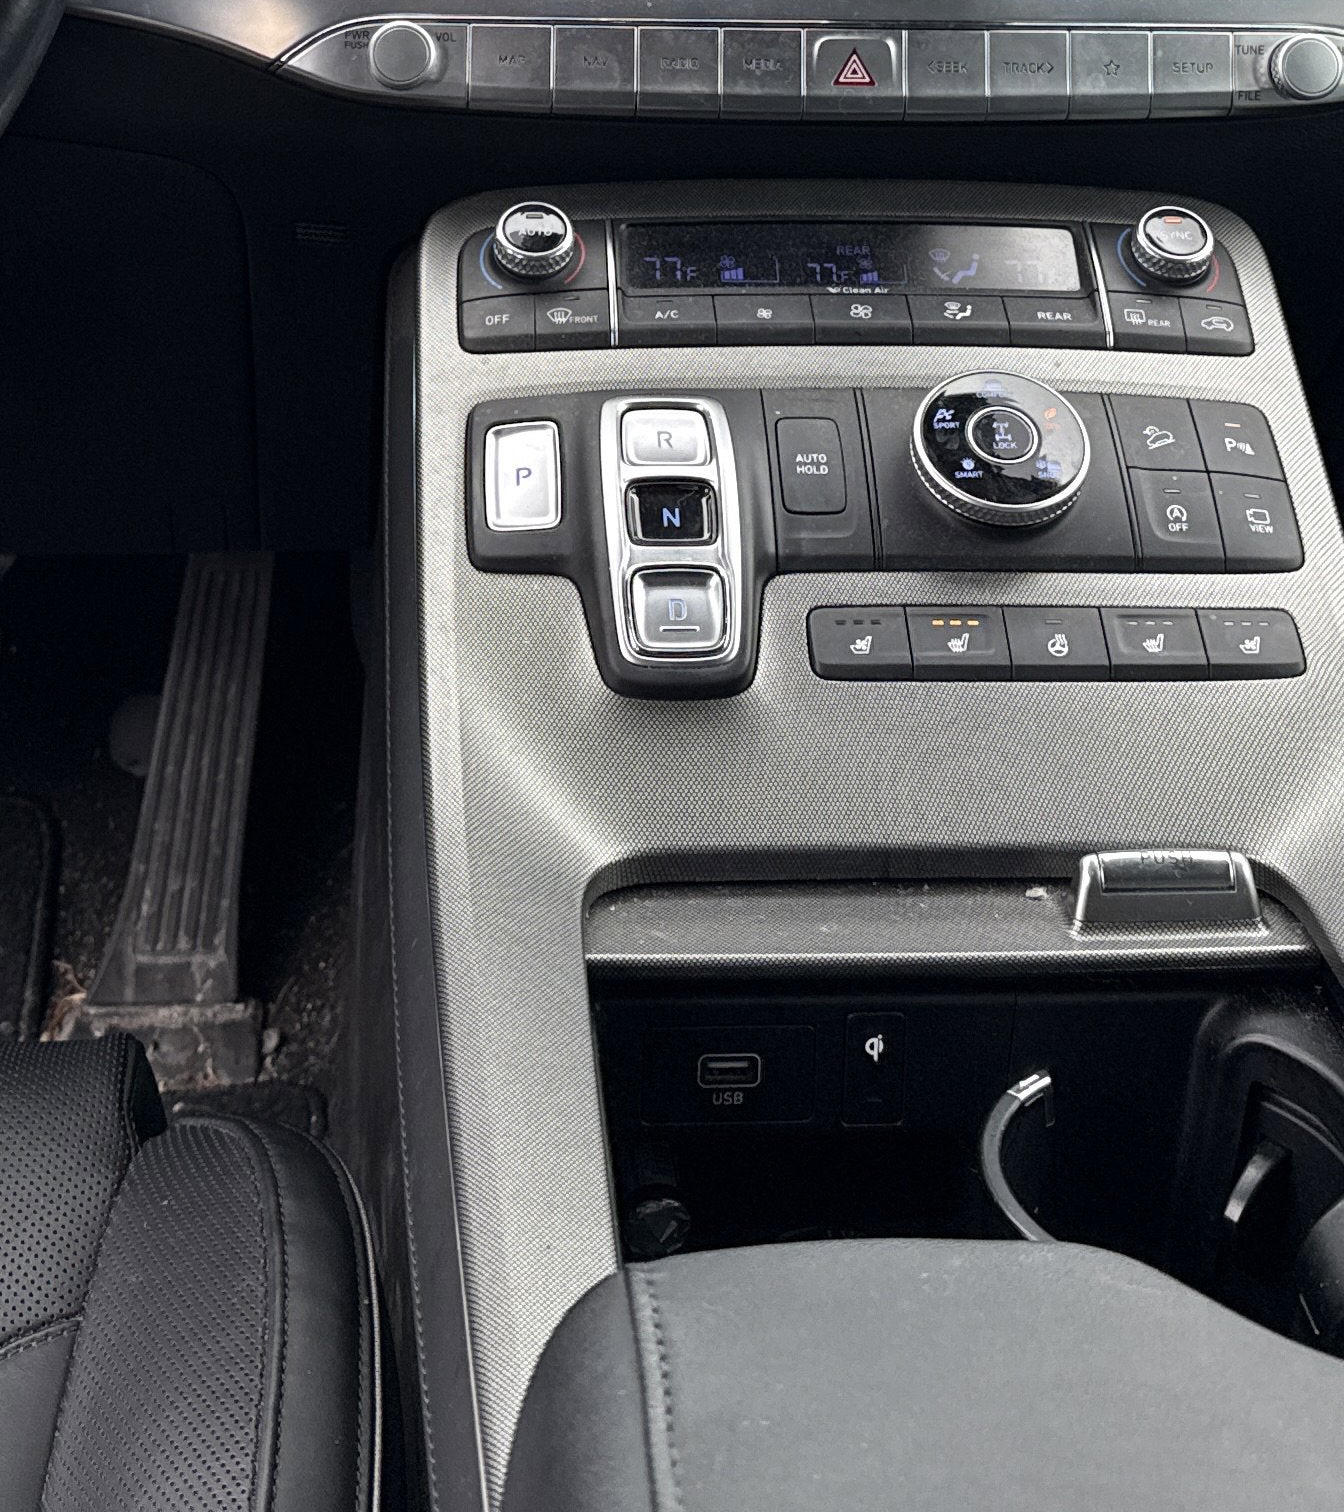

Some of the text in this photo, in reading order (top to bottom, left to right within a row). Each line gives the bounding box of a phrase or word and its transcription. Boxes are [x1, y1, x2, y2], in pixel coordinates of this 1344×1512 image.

[344, 30, 370, 39] PWR
[435, 31, 456, 42] VOL
[344, 41, 369, 50] PUSH
[1235, 44, 1265, 56] TUNE
[498, 54, 525, 65] MAP
[583, 55, 609, 66] NAV
[1171, 61, 1214, 73] SETUP
[1238, 90, 1262, 101] FILE
[517, 228, 554, 237] AUTO
[1159, 231, 1193, 241] SYNC
[836, 245, 871, 256] REAR
[842, 286, 889, 295] Clean Air
[485, 313, 510, 326] OFF
[568, 314, 599, 324] FRONT
[655, 309, 680, 320] A/C
[1036, 311, 1073, 322] REAR
[1147, 319, 1171, 328] REAR
[932, 421, 960, 430] SPORT
[656, 431, 673, 449] R
[992, 441, 1018, 450] LOCK
[795, 453, 827, 463] AUTO
[796, 464, 828, 475] HOLD
[954, 470, 984, 479] SMART
[515, 467, 532, 487] P
[662, 507, 681, 528] N
[1167, 522, 1189, 532] OFF
[1248, 524, 1274, 534] VIEW
[668, 597, 688, 621] D
[1140, 850, 1194, 865] PUSH
[712, 1091, 744, 1105] USB
